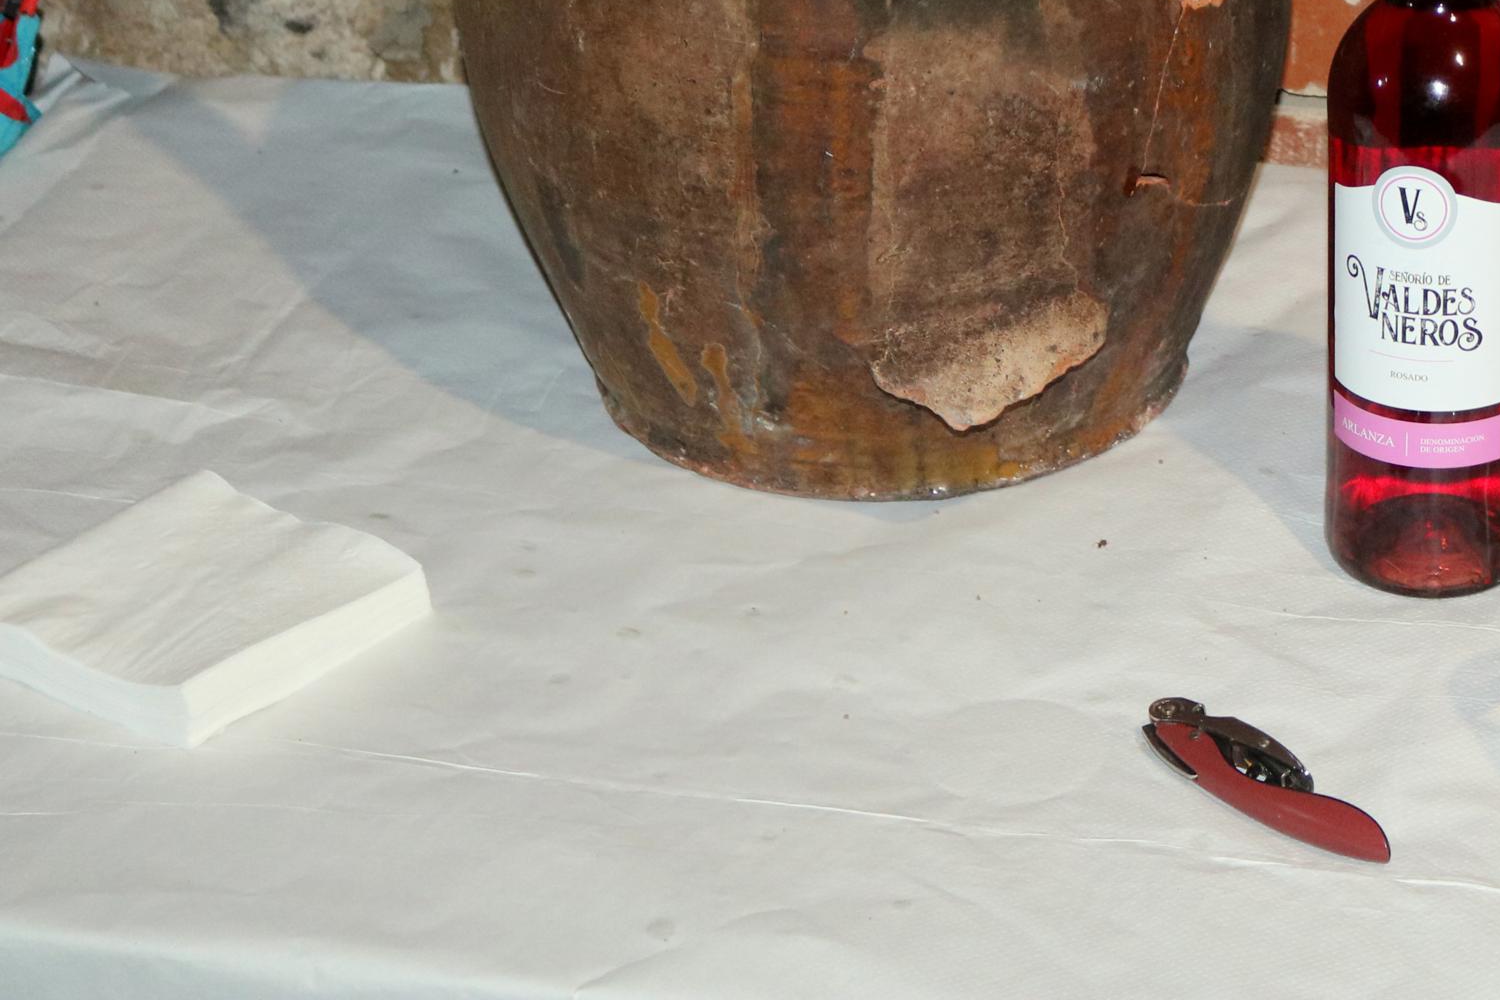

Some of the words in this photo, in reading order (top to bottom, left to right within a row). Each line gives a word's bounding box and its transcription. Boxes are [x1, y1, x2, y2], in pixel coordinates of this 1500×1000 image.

[1346, 254, 1476, 320] VALDES
[1437, 274, 1452, 286] DE
[1381, 311, 1483, 352] NEROS
[1389, 370, 1429, 382] ROSADO
[1341, 416, 1396, 448] ARLANZA
[1419, 445, 1432, 453] DE
[1433, 444, 1466, 453] ORIGEN
